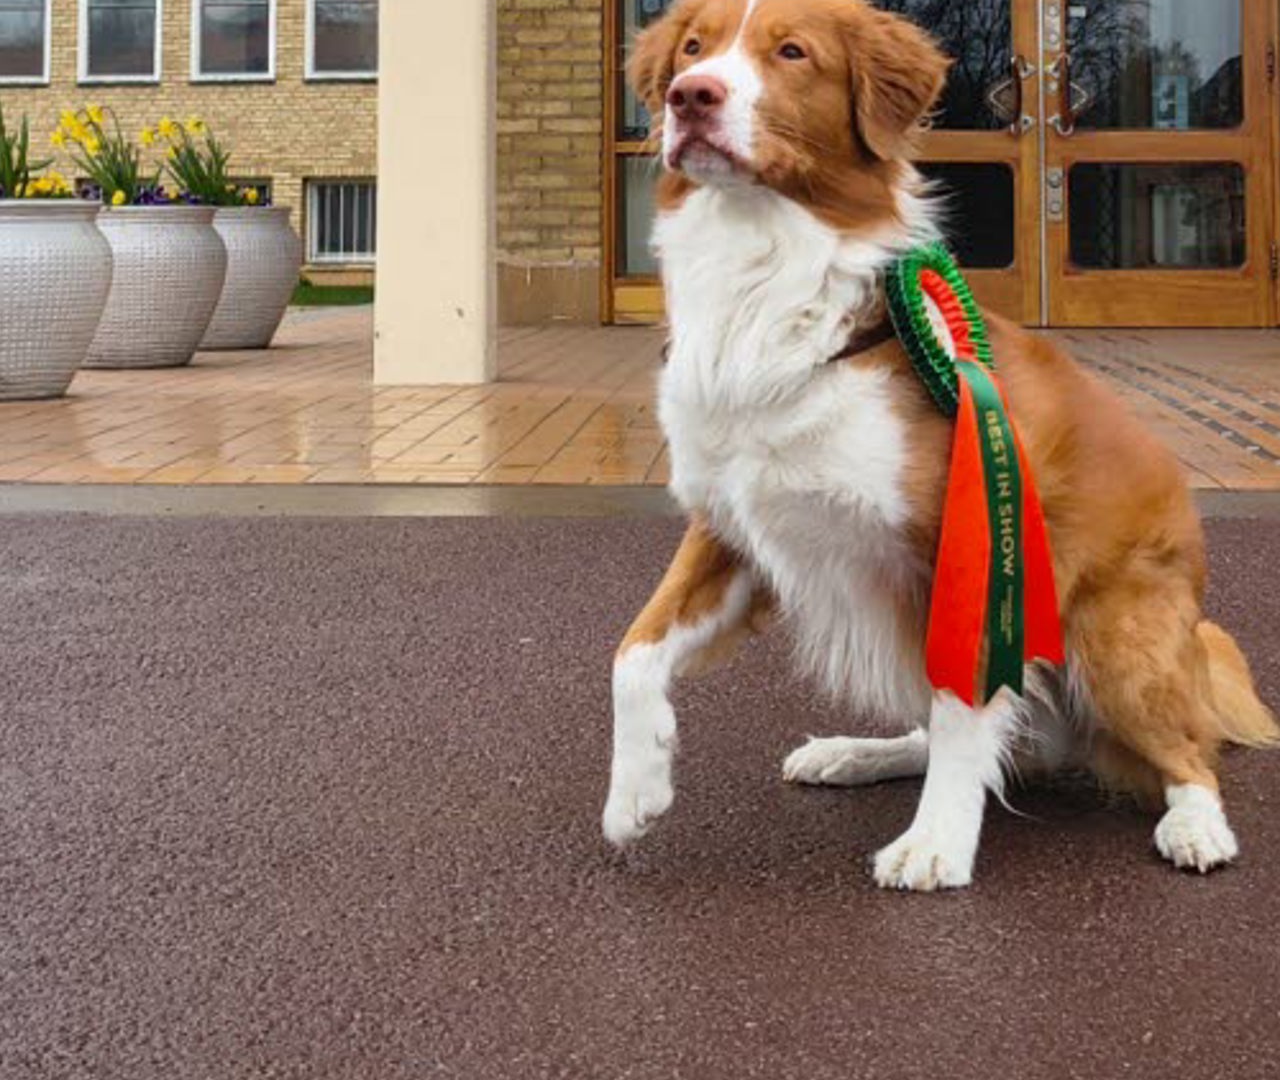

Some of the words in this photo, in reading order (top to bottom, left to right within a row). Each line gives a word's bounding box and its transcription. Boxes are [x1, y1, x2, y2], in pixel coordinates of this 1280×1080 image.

[985, 410, 1009, 465] BEST
[997, 472, 1012, 497] IN
[998, 504, 1014, 576] SHOW
